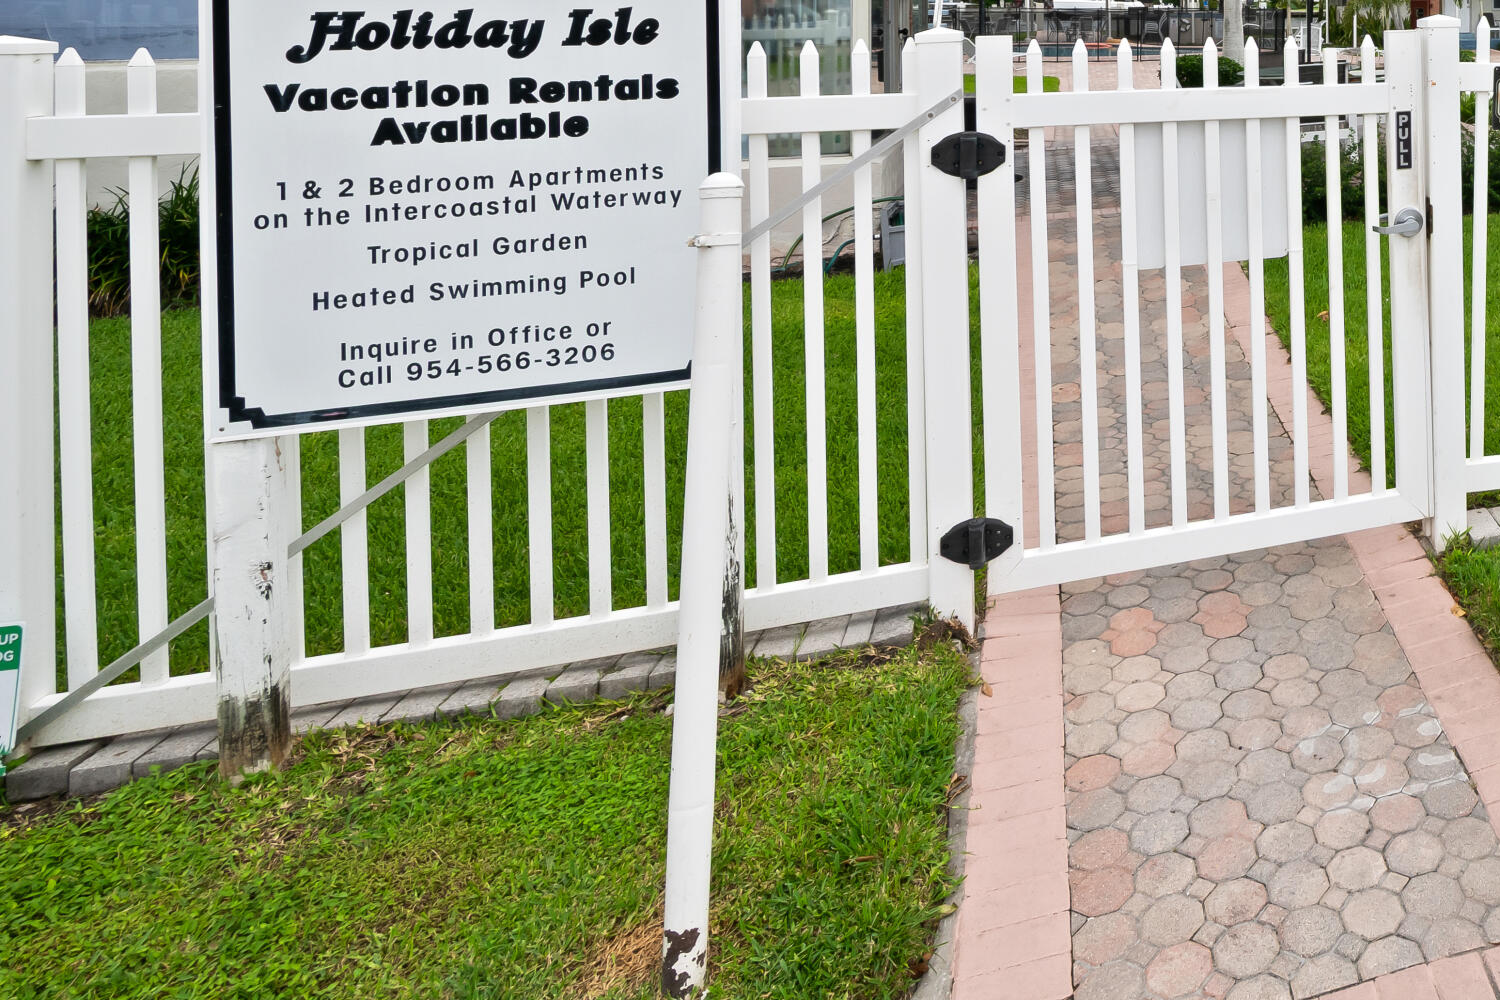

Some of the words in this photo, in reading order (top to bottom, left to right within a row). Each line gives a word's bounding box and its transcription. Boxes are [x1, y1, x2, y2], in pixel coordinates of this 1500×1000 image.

[285, 8, 546, 64] Holiday
[561, 6, 660, 47] Isle
[262, 79, 489, 113] Vacation
[509, 73, 680, 105] Rentals
[370, 111, 590, 147] Available
[1398, 114, 1409, 167] PULL
[276, 181, 286, 201] 1
[302, 180, 322, 200] &
[338, 178, 354, 198] 2
[369, 174, 494, 196] Bedroom
[508, 163, 664, 192] Apartments
[253, 213, 288, 230] on
[303, 207, 350, 227] the
[365, 194, 536, 223] Intercoastal
[550, 189, 682, 211] Waterway
[367, 238, 478, 266] Tropical
[492, 233, 587, 256] Garden
[312, 284, 414, 311] Heated
[429, 274, 567, 301] Swimming
[580, 266, 635, 289] Pool
[340, 336, 437, 363] Inquire
[451, 332, 473, 351] in
[487, 325, 572, 347] Office
[586, 321, 612, 337] or
[338, 365, 392, 389] Call
[406, 341, 616, 382] 954-566-3206
